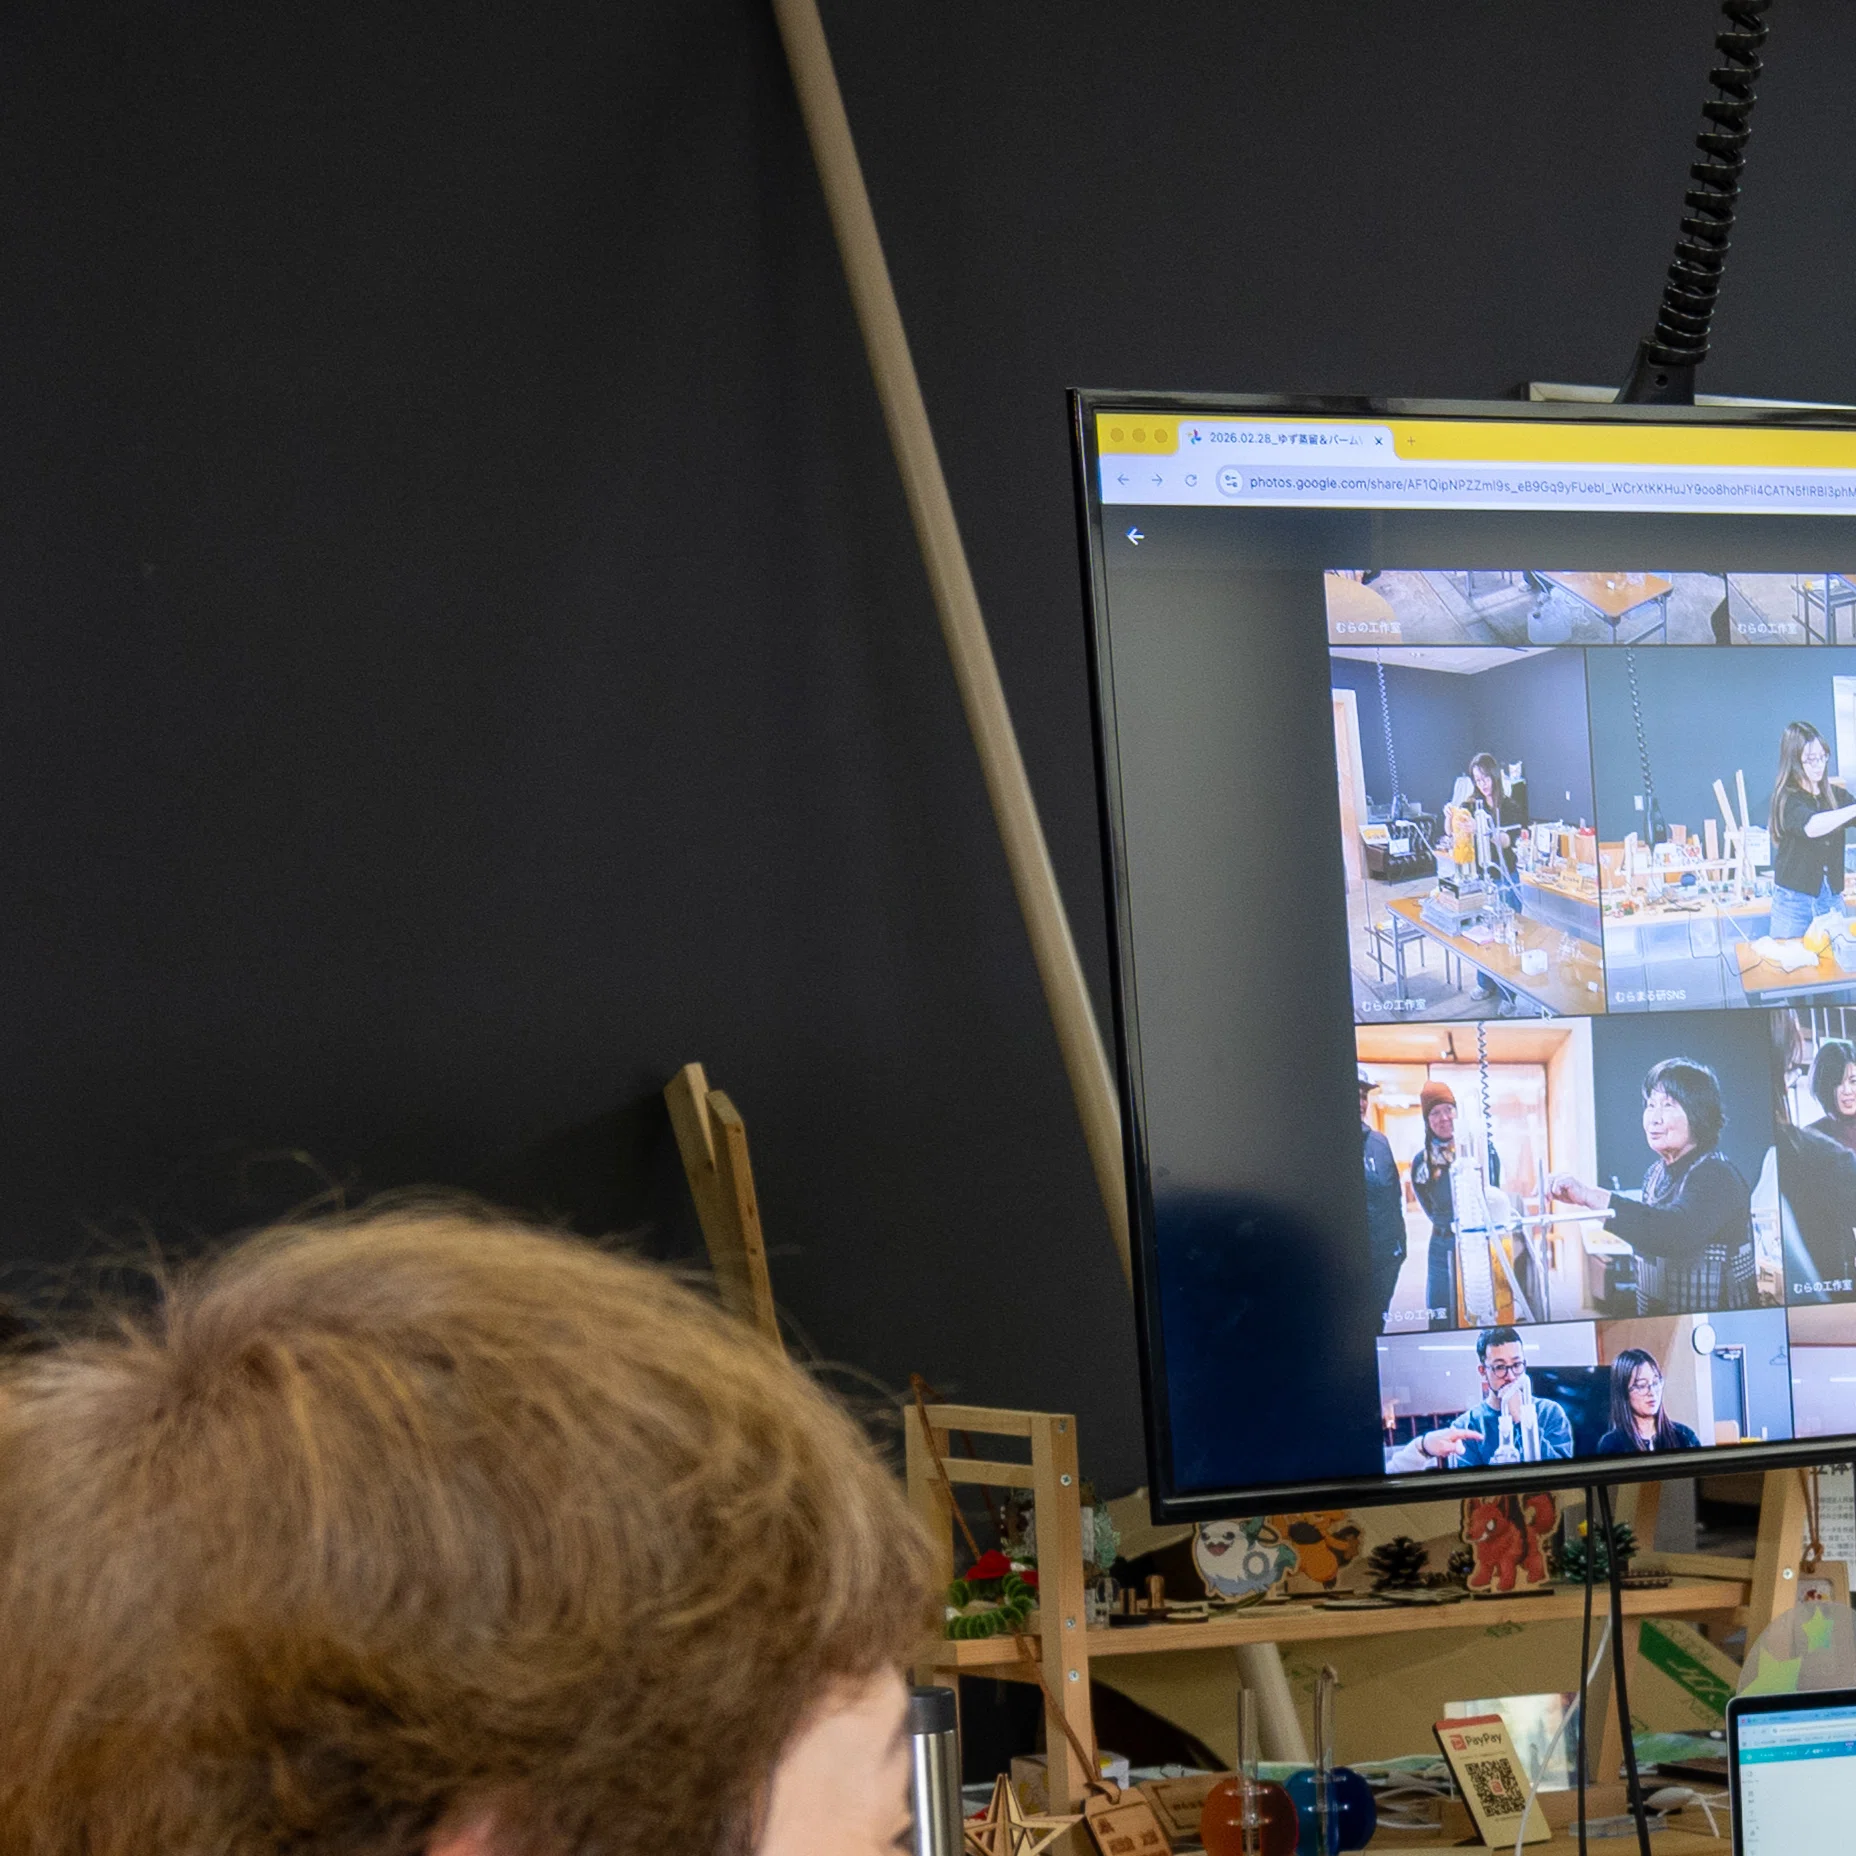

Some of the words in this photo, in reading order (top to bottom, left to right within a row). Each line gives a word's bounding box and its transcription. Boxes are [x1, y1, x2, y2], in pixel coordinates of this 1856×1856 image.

[1361, 998, 1427, 1012] むらの工作室
[1465, 1732, 1502, 1747] PayPay
